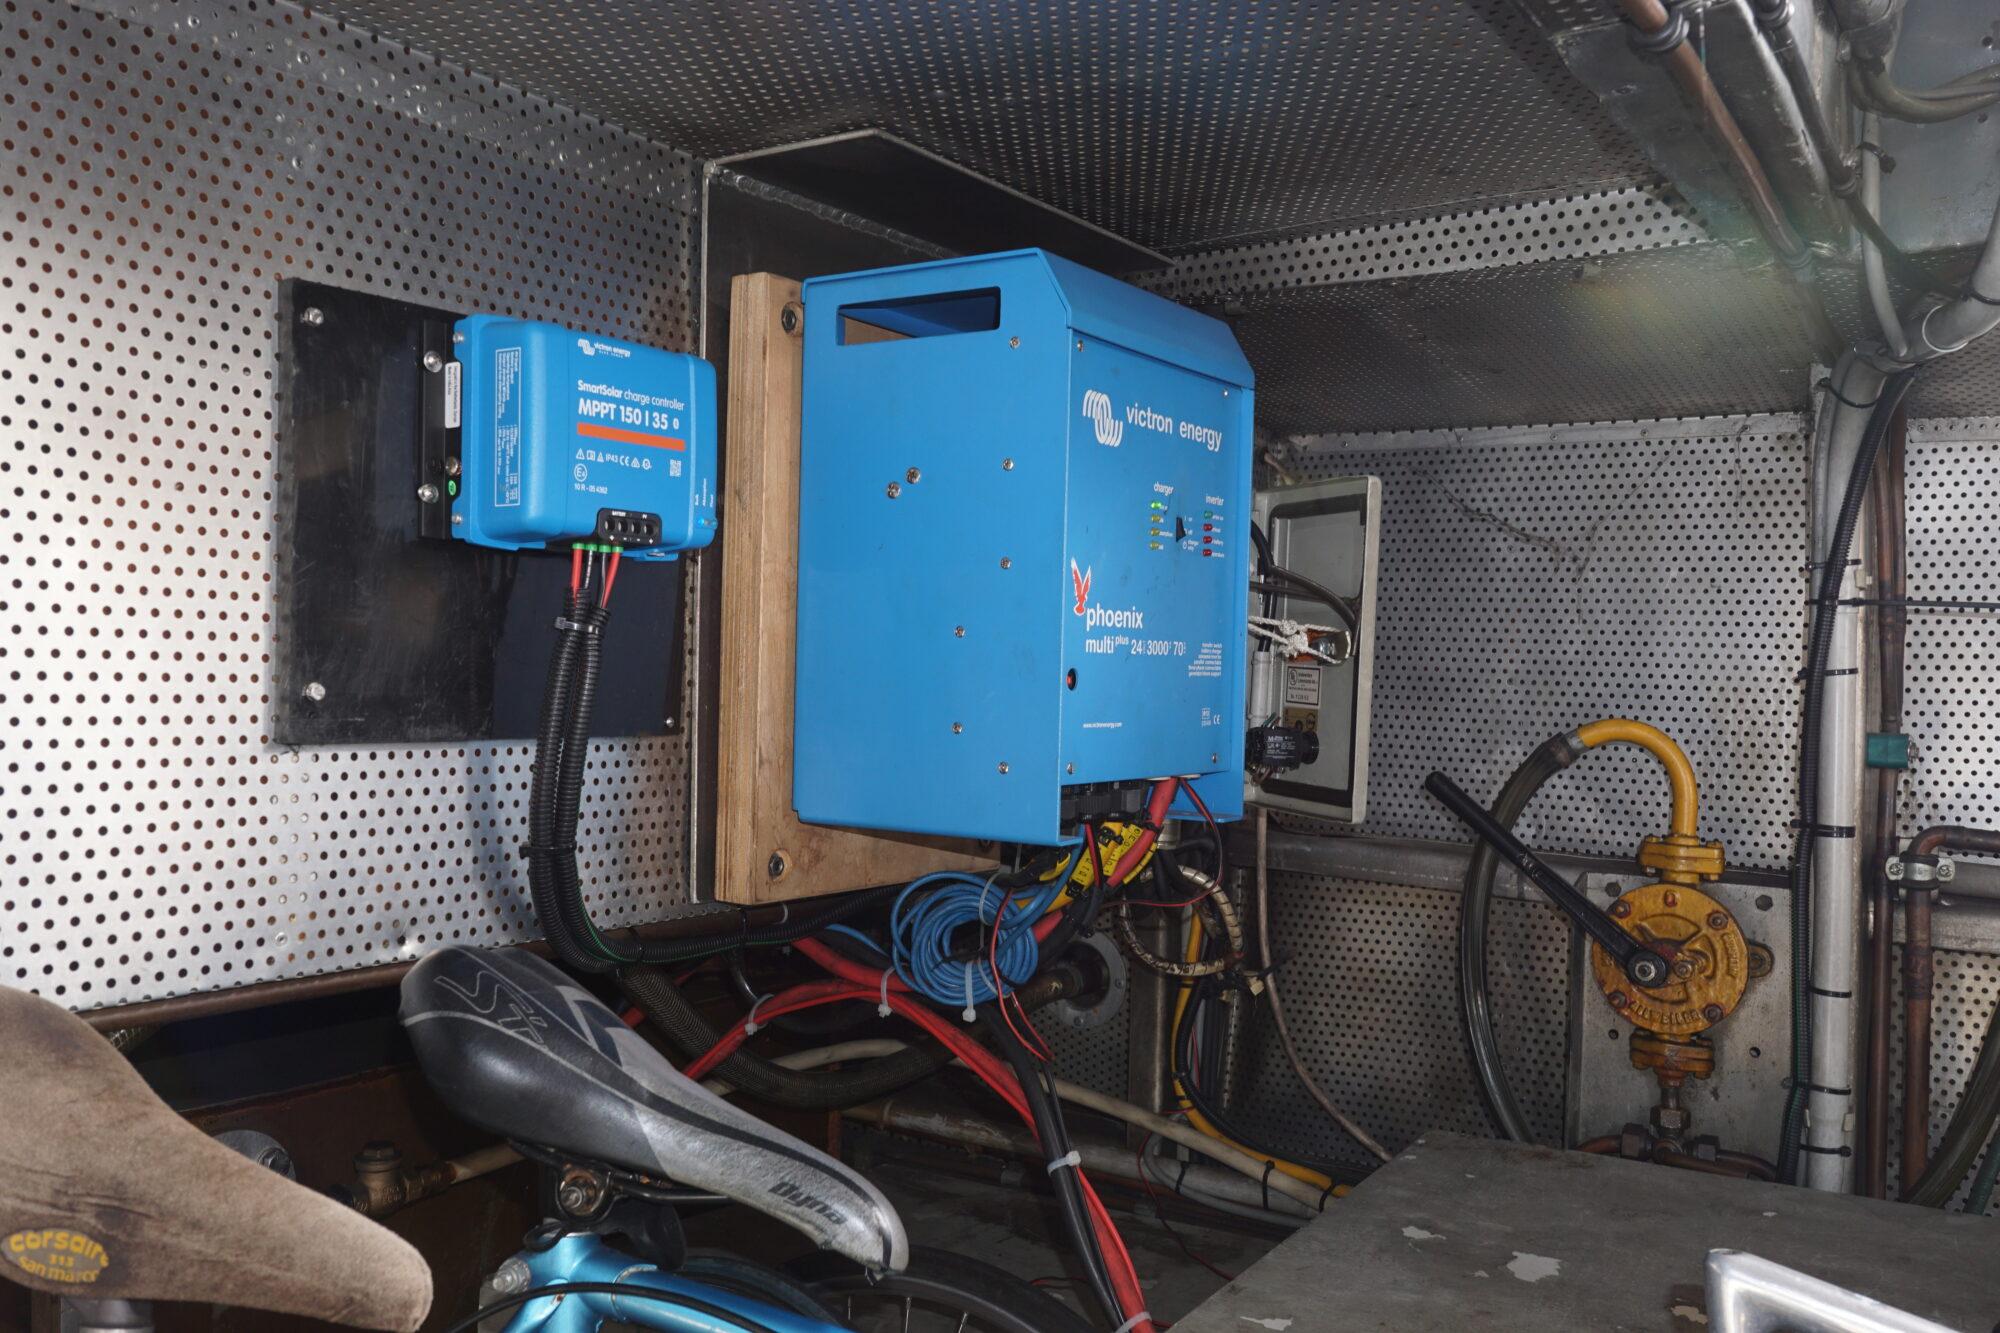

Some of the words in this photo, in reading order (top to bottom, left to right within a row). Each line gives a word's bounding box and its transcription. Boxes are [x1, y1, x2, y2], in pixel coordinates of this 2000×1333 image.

[594, 342, 612, 351] victron
[613, 347, 631, 358] energy
[577, 379, 623, 399] SmartSolar
[624, 388, 650, 405] charge
[651, 396, 685, 411] controller
[578, 397, 617, 420] MPPT
[619, 405, 642, 425] 150
[652, 411, 669, 430] 35
[1126, 403, 1173, 435] victron
[1179, 420, 1222, 452] energy
[1153, 481, 1174, 496] charger
[1205, 493, 1224, 506] inverter
[1086, 603, 1143, 632] phoenix
[1085, 635, 1114, 654] multi
[1115, 634, 1129, 645] plus
[1131, 641, 1143, 655] 24
[1146, 641, 1169, 656] 3000
[1173, 642, 1184, 656] 70
[768, 1182, 848, 1225] Dyna
